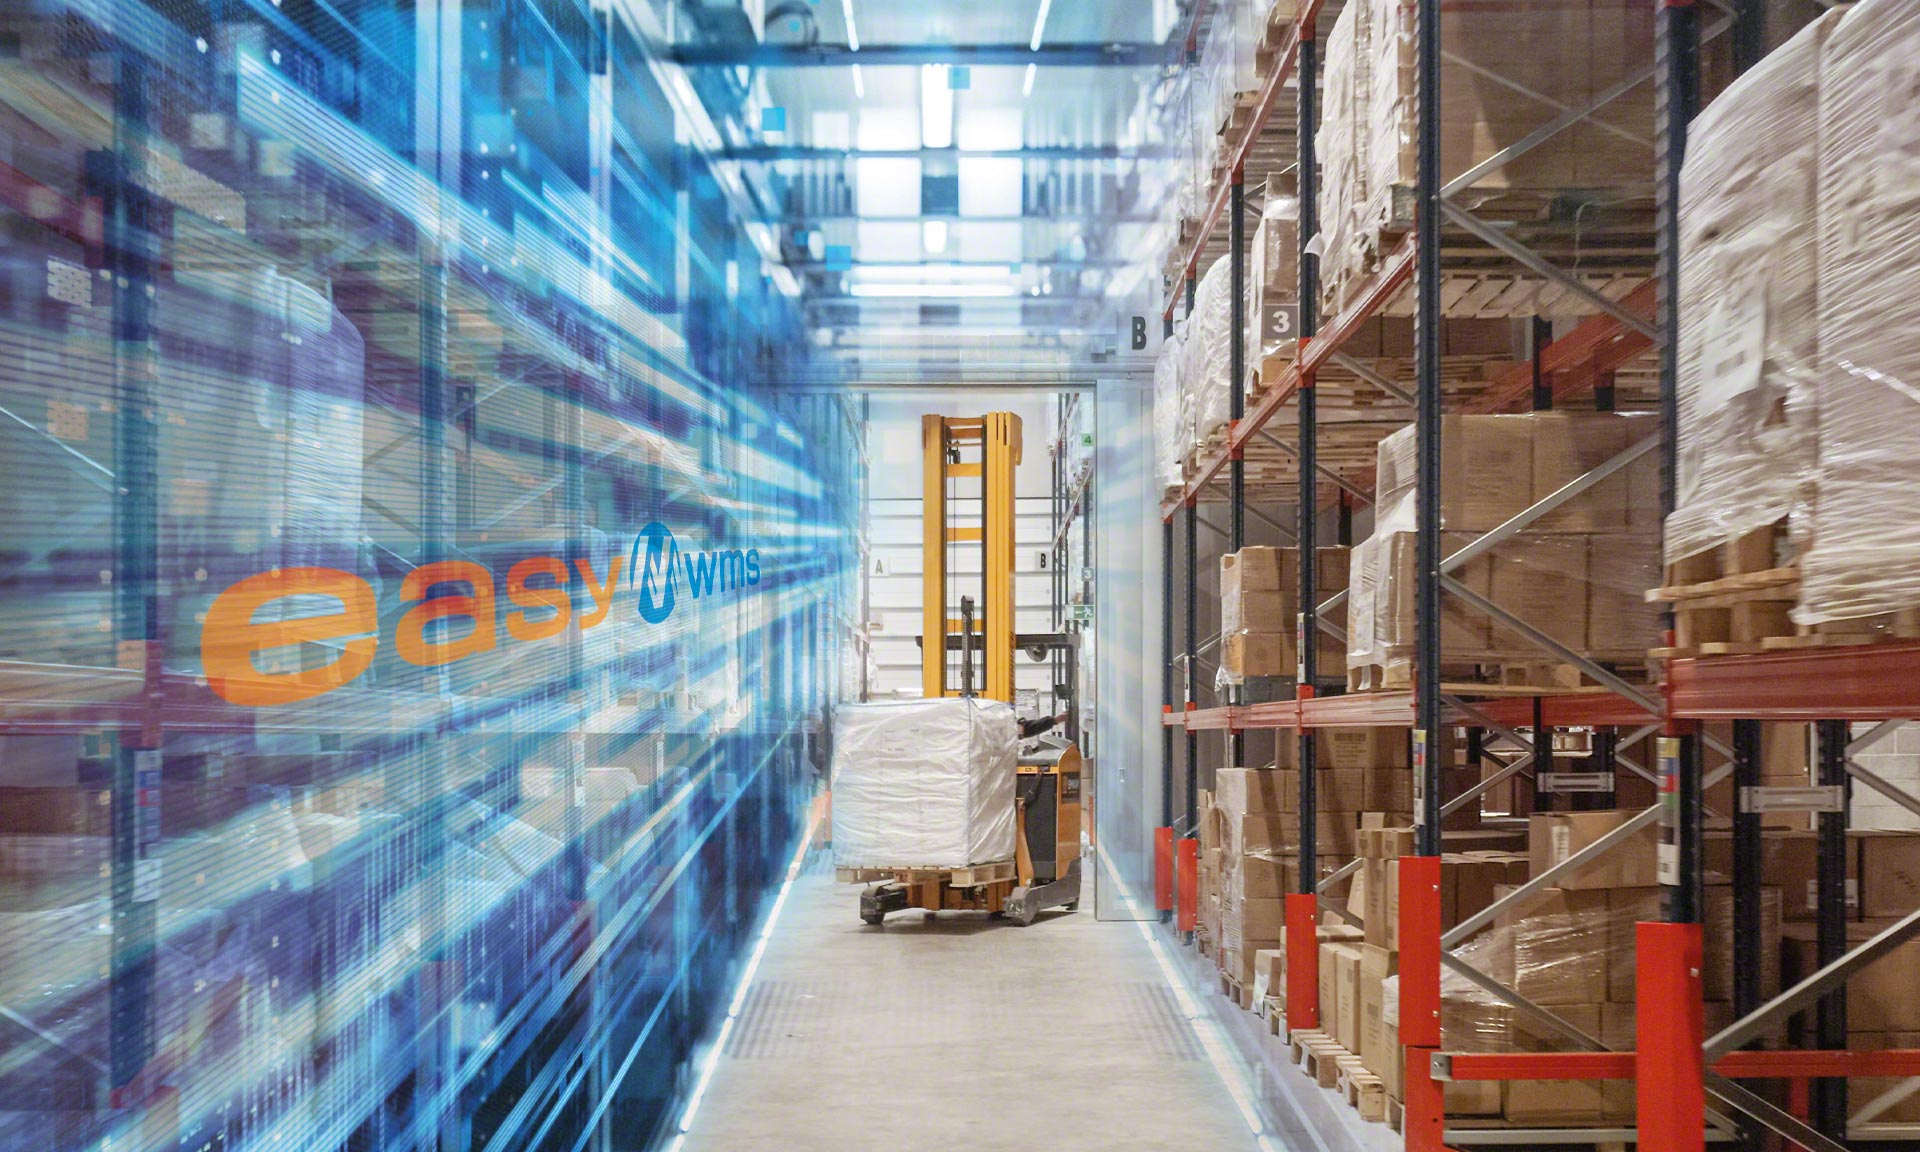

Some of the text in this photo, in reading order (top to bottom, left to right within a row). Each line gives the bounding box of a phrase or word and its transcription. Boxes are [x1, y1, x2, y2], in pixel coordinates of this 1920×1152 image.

[1272, 310, 1291, 334] 3
[1131, 315, 1147, 351] B
[1085, 435, 1092, 445] 4
[876, 559, 884, 574] A
[1040, 553, 1047, 568] B
[1084, 569, 1092, 580] 3
